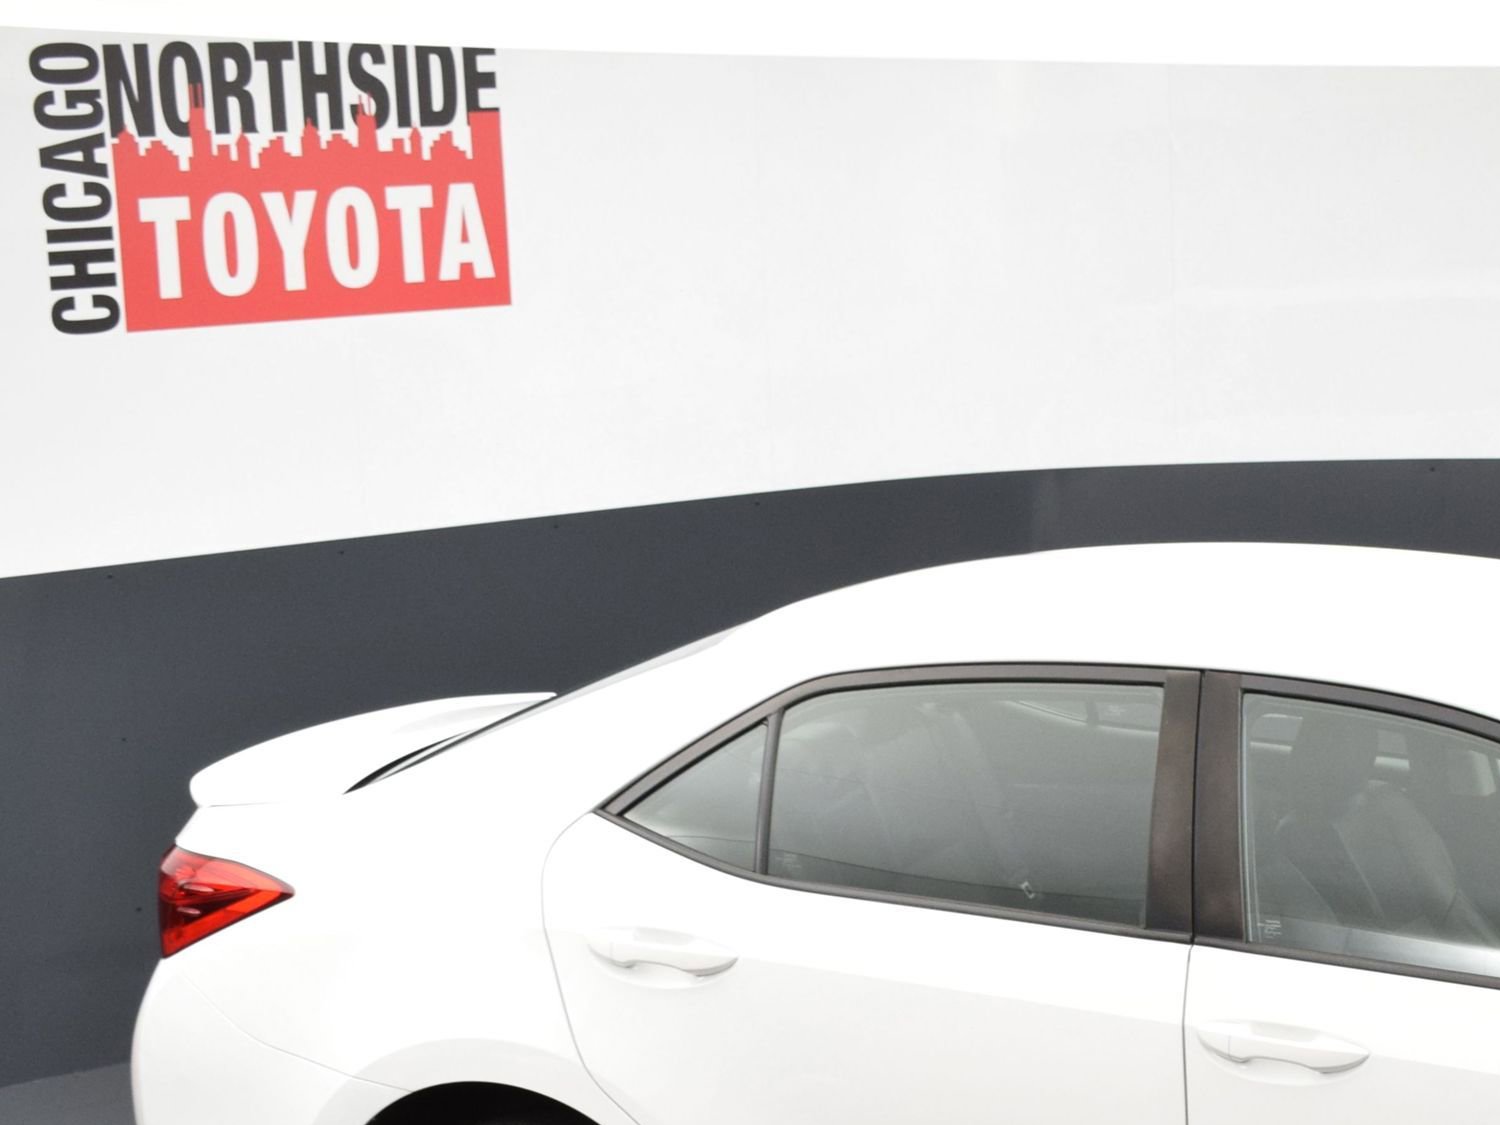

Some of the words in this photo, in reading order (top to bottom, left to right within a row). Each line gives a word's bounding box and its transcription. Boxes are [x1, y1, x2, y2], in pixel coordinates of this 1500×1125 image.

[102, 40, 498, 138] NORTHSIDE
[29, 42, 121, 336] CHICAGO
[138, 182, 496, 299] TOYOTA
